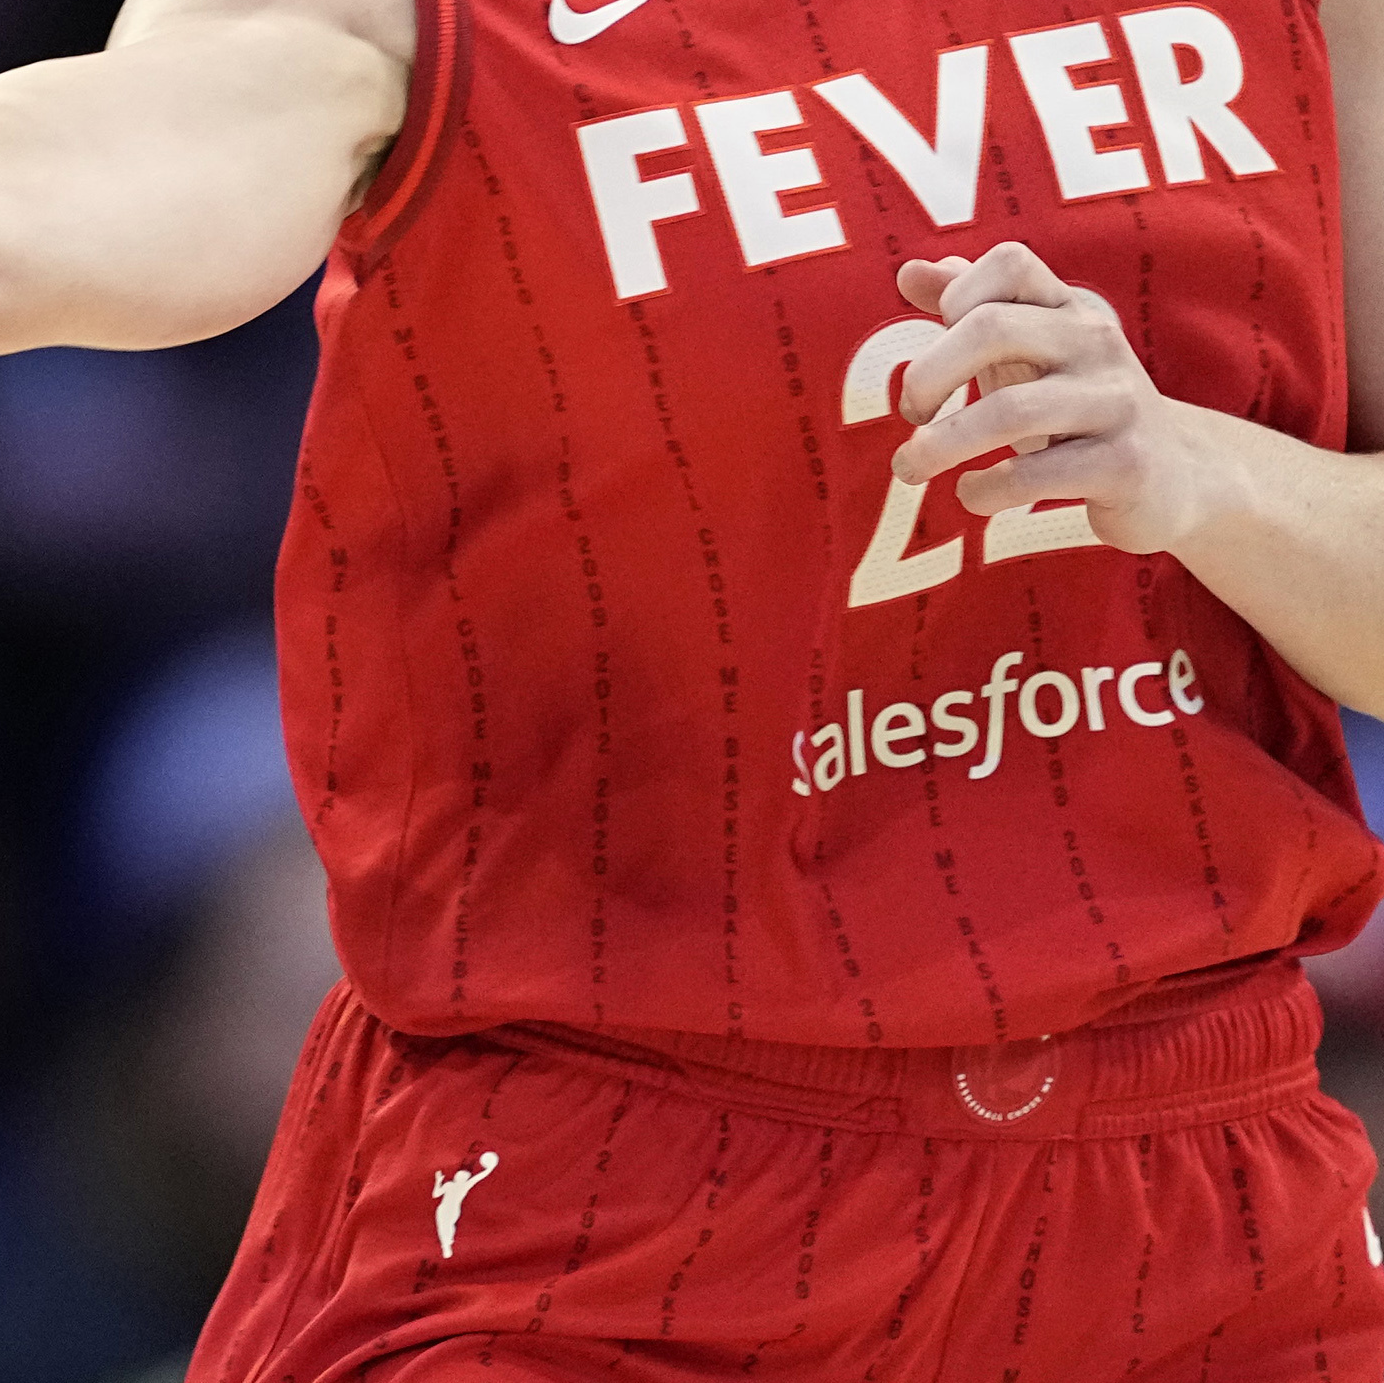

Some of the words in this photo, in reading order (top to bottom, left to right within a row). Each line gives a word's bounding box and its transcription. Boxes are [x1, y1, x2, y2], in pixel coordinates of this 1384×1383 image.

[571, 4, 1283, 305] FEVER
[413, 373, 464, 602] BASKETBALL
[696, 526, 734, 645] CHOSE
[456, 617, 488, 741] CHOSE
[593, 650, 612, 755] 2012
[718, 665, 740, 715] ME
[790, 649, 1205, 798] salesforce
[471, 760, 493, 809] ME
[591, 776, 610, 877] 2020
[1170, 726, 1236, 955] BASKETBAL
[721, 735, 742, 985] BASKETBALL
[932, 847, 960, 897] ME
[955, 915, 1008, 1041] BASKE
[1012, 1215, 1048, 1346] CHOSE
